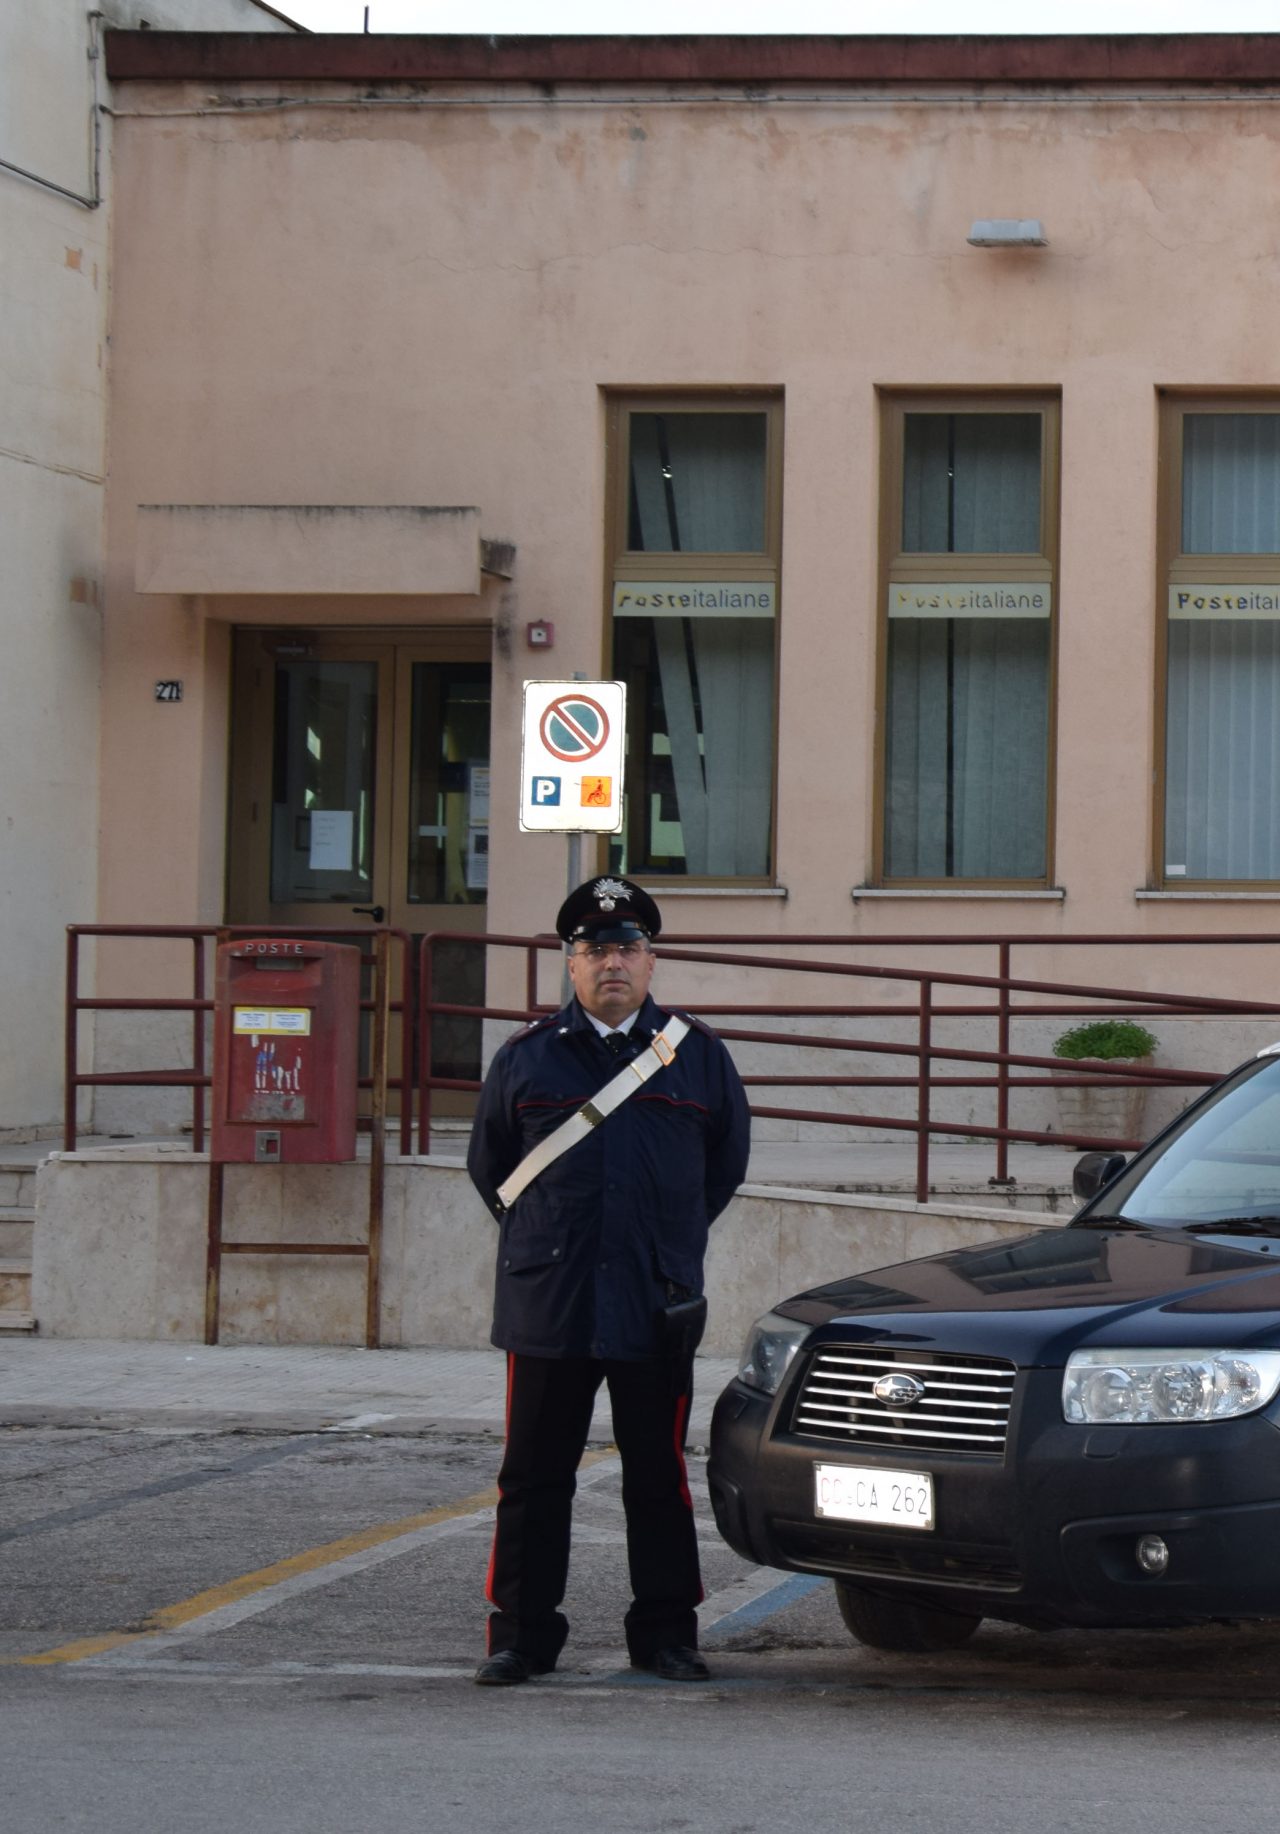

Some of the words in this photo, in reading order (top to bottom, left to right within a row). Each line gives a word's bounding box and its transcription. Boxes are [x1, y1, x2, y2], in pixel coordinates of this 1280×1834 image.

[536, 779, 556, 803] P
[245, 943, 304, 954] POSTE
[891, 1484, 928, 1516] 262
